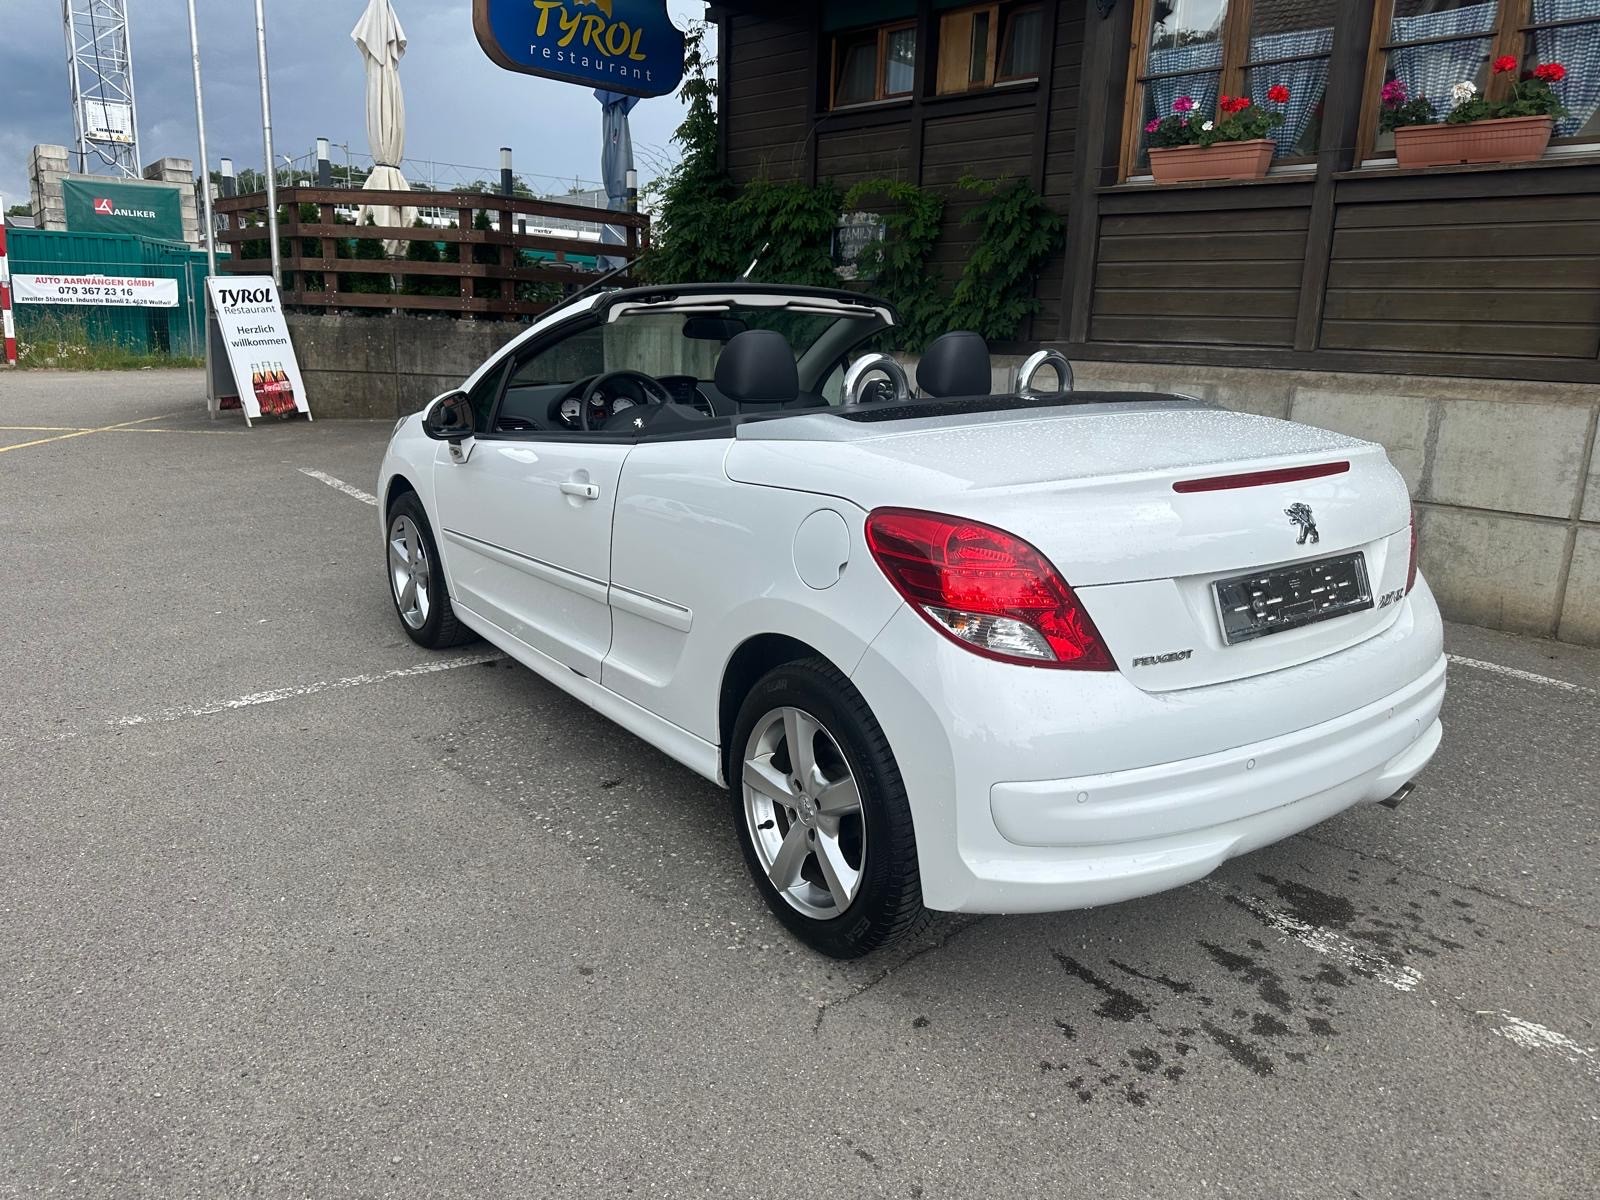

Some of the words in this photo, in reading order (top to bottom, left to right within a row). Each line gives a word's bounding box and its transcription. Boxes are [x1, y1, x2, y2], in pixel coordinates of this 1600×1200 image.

[533, 0, 647, 61] TYROL
[530, 43, 652, 82] restaurant
[63, 278, 124, 287] AARWANGEN
[127, 279, 155, 287] GMBH
[58, 286, 78, 295] 079
[81, 286, 101, 295] 367
[103, 287, 117, 296] 23
[120, 288, 134, 296] 16
[218, 288, 272, 307] TYROL
[223, 306, 276, 315] Restaurant
[236, 324, 275, 334] Herzlich
[231, 338, 287, 347] willkommen
[1132, 649, 1194, 667] PEUGEOT
